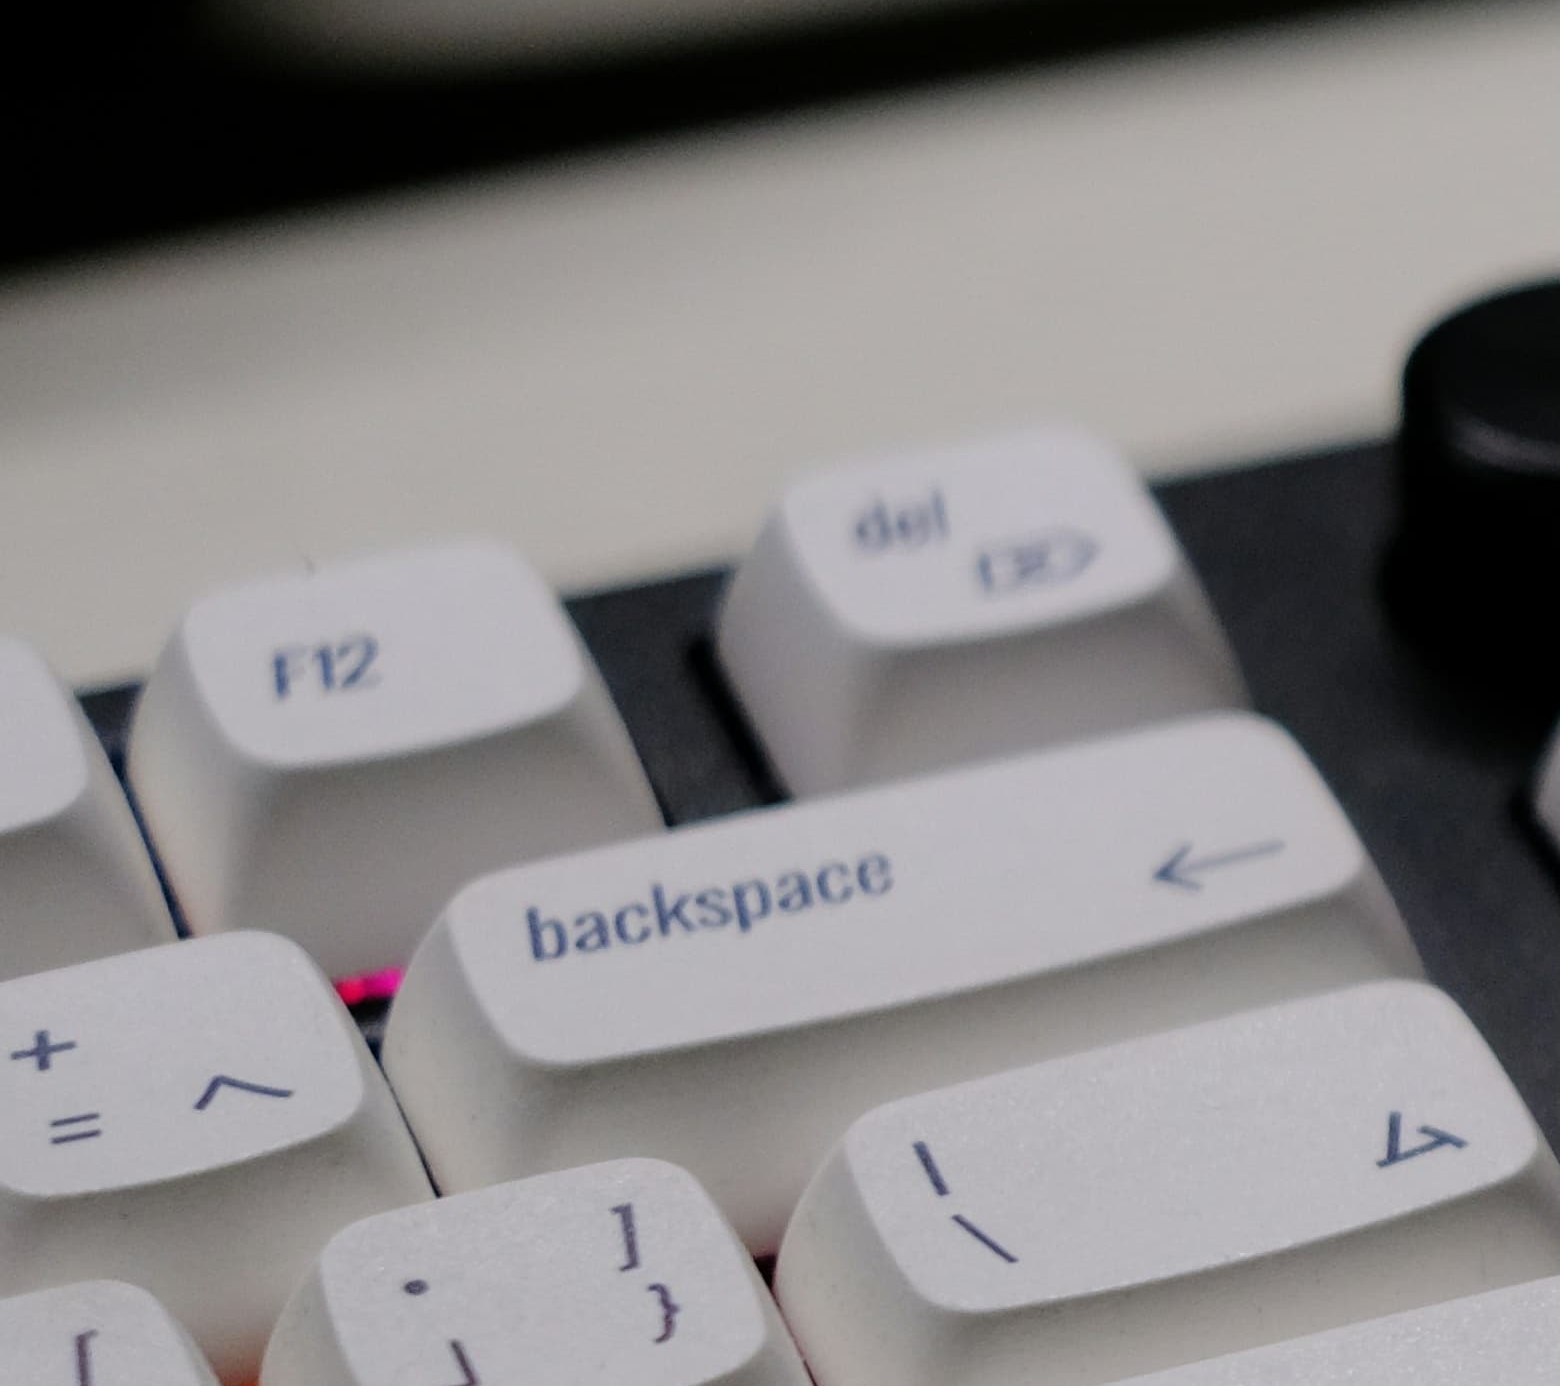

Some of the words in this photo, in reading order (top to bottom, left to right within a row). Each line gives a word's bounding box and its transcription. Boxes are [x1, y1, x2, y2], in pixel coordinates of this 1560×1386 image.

[852, 490, 949, 556] del
[271, 637, 382, 700] F12
[526, 851, 895, 962] backspace
